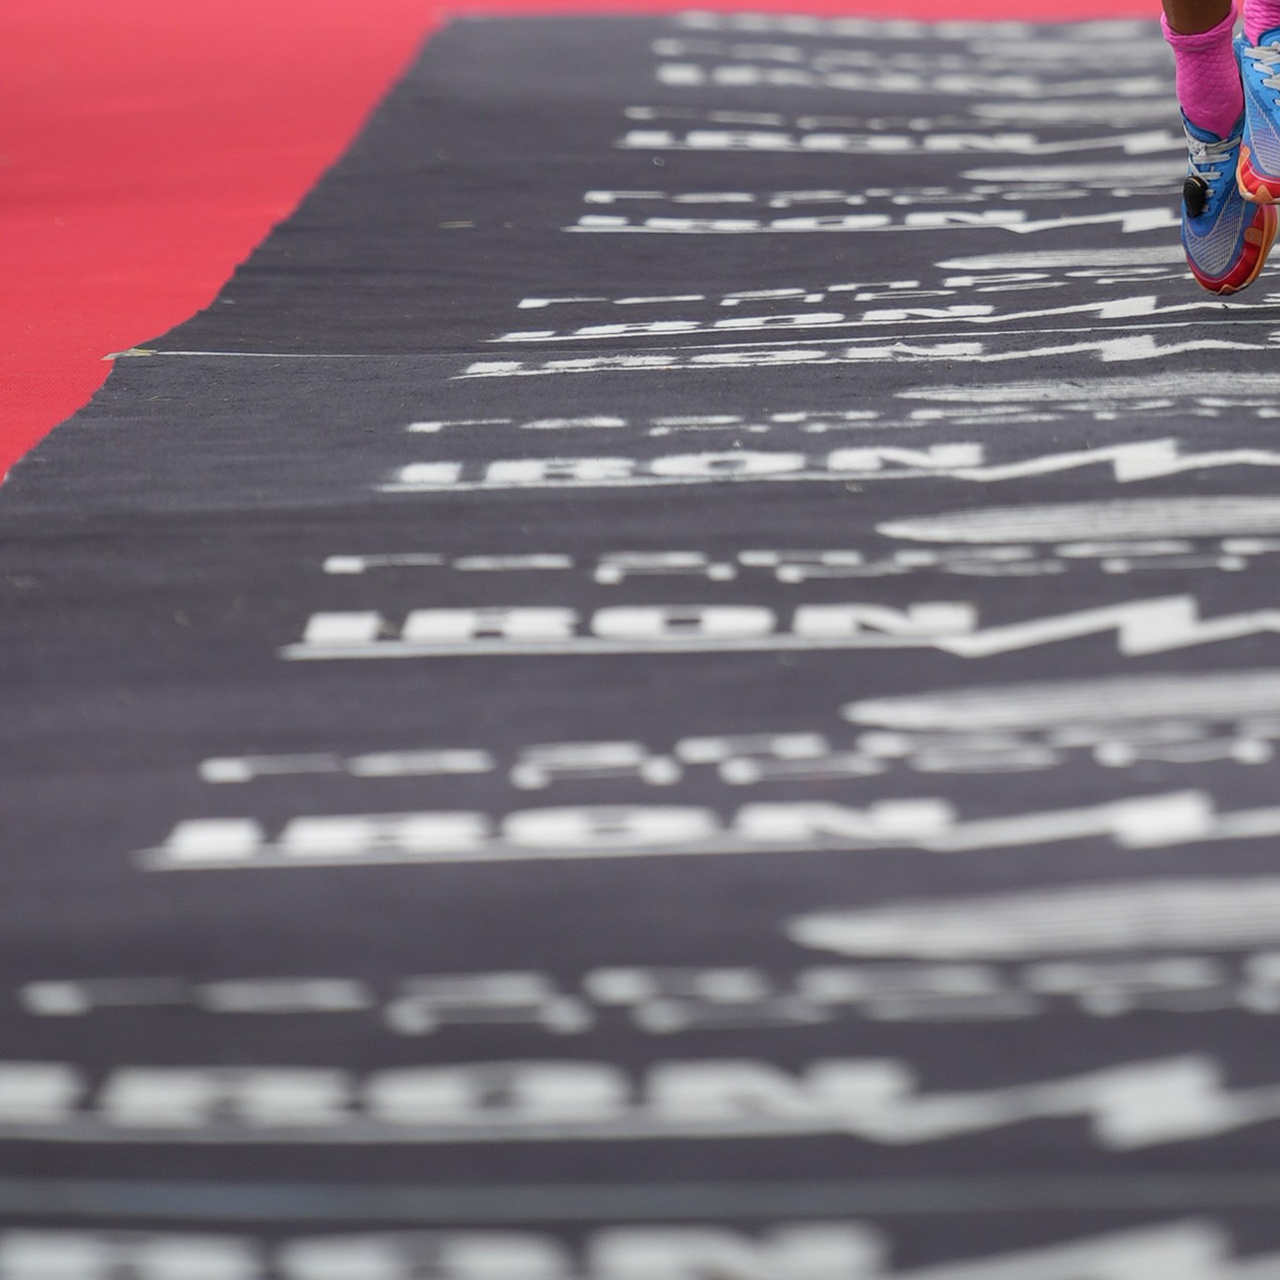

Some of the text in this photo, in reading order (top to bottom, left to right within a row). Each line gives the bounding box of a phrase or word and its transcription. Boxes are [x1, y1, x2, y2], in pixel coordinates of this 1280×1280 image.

[578, 209, 1026, 230] IRON
[498, 305, 994, 340] IRON
[464, 342, 983, 374] IRON
[398, 442, 984, 484] IRON
[302, 600, 977, 647] IRON
[165, 796, 950, 861] IRON
